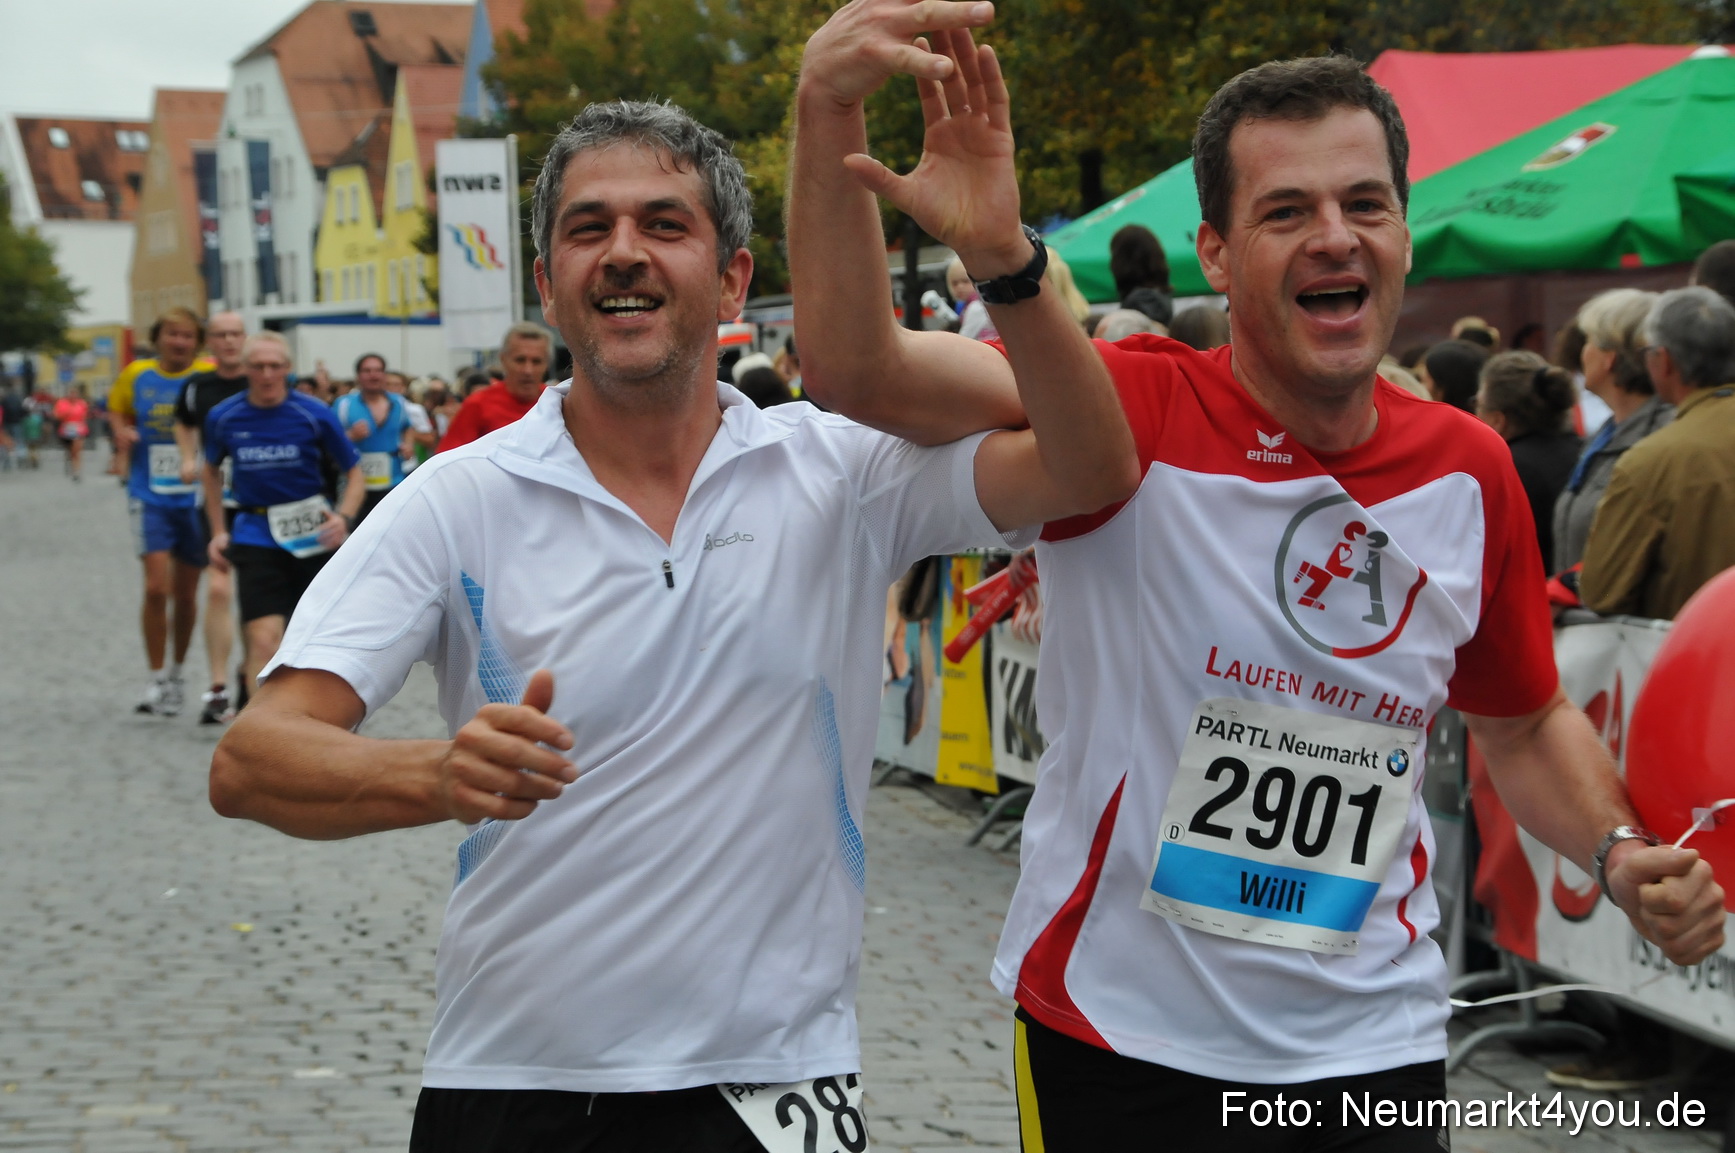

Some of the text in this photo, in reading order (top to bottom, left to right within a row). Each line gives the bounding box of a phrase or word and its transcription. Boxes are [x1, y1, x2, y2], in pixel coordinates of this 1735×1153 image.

[1246, 449, 1293, 464] erima
[713, 532, 755, 548] odlo
[1205, 645, 1303, 696] LAUFEN
[1311, 681, 1366, 712] MIT
[1195, 715, 1379, 770] PARTL Neumarkt
[1188, 756, 1383, 866] 2901
[1239, 871, 1307, 914] Willi
[775, 1073, 867, 1153] 28
